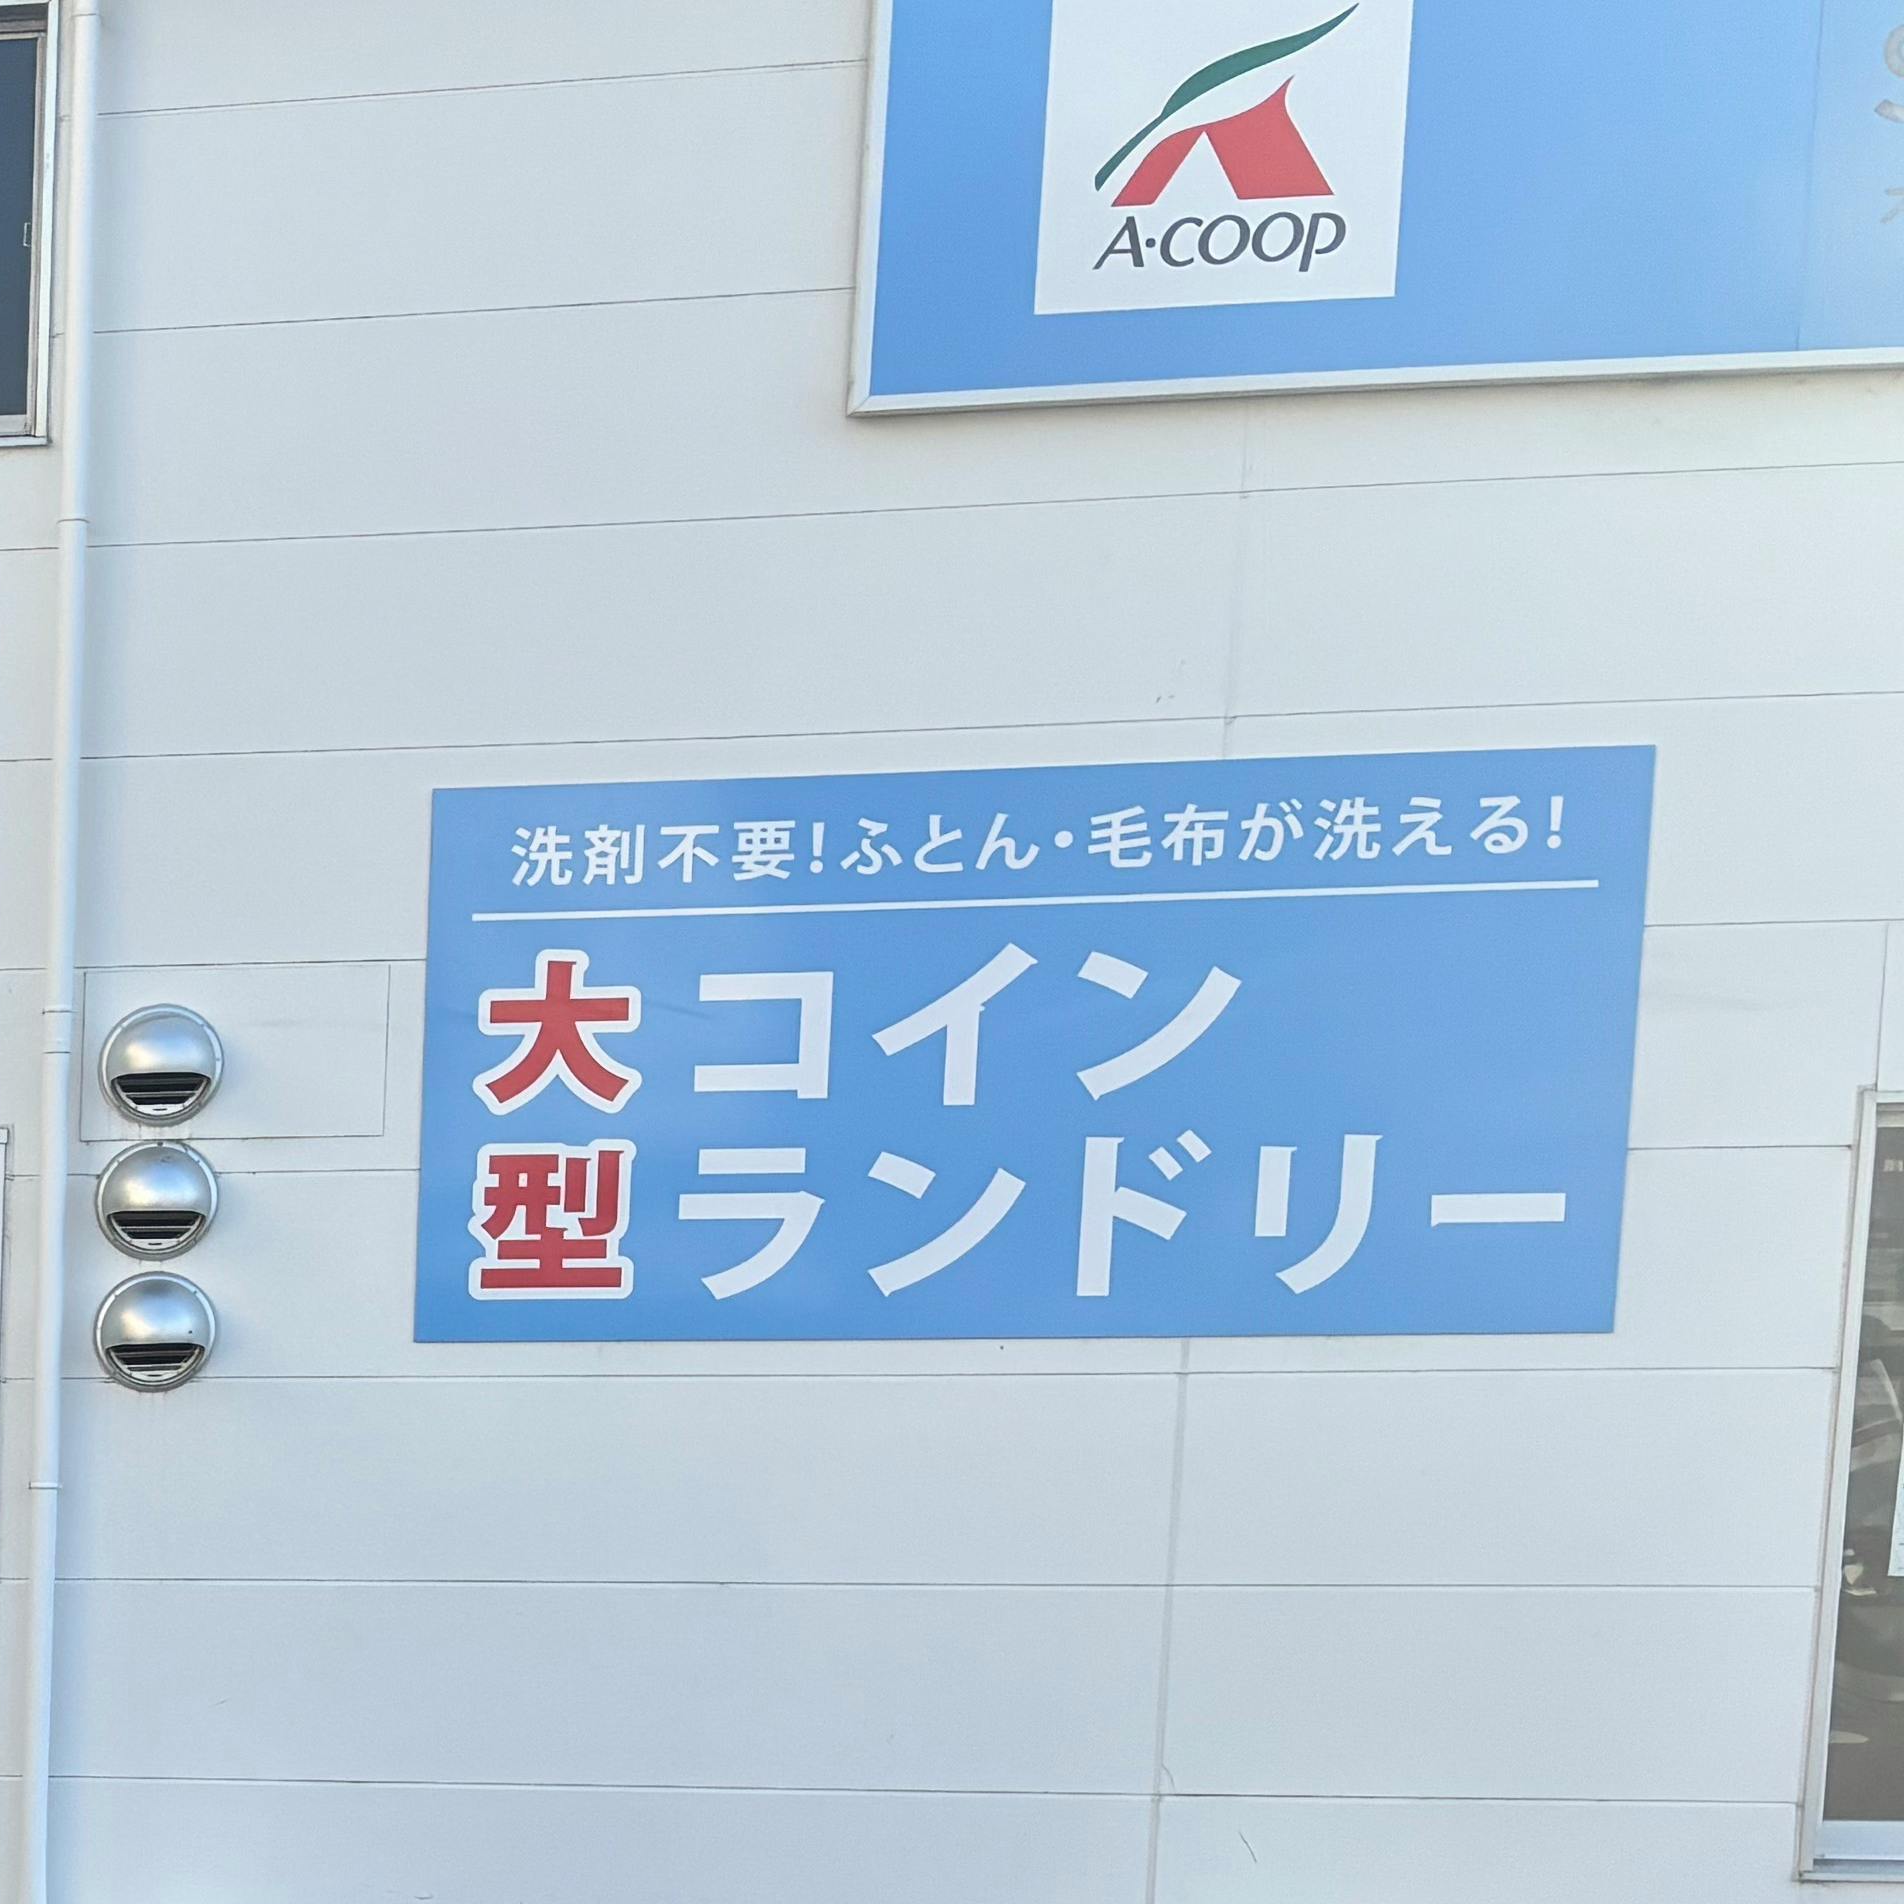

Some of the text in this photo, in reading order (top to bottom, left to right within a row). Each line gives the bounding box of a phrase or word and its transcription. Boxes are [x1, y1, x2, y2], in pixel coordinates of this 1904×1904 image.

[510, 795, 1565, 888] 洗剤不要!ふとん・毛布が洗える!
[694, 943, 1242, 1106] コイン
[678, 1129, 1567, 1300] ランドリー
